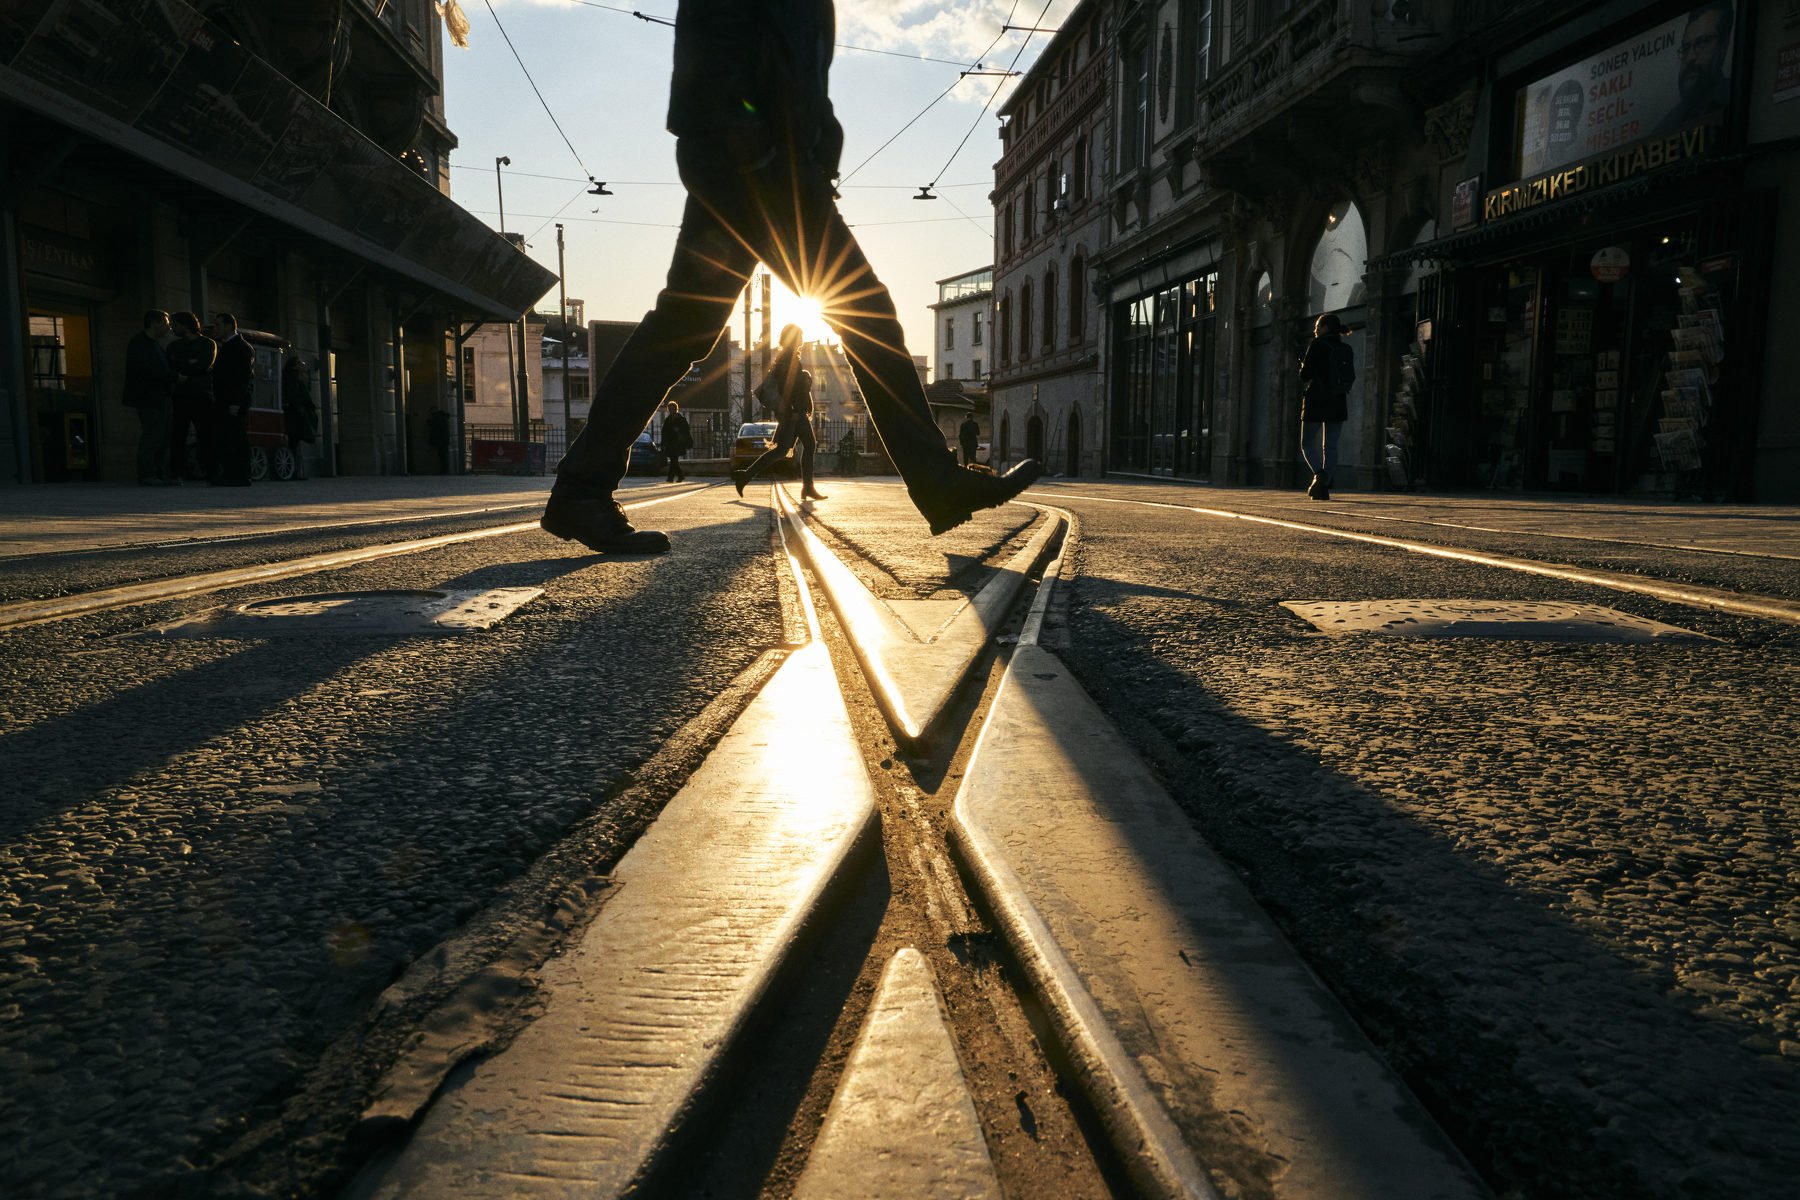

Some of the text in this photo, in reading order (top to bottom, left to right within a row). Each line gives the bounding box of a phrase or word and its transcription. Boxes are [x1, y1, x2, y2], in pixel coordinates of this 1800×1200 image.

[191, 30, 215, 53] 1961
[1591, 31, 1675, 80] SONER YALÇIN
[1589, 71, 1632, 102] SAKLI
[1484, 177, 1547, 220] KIRMIZI
